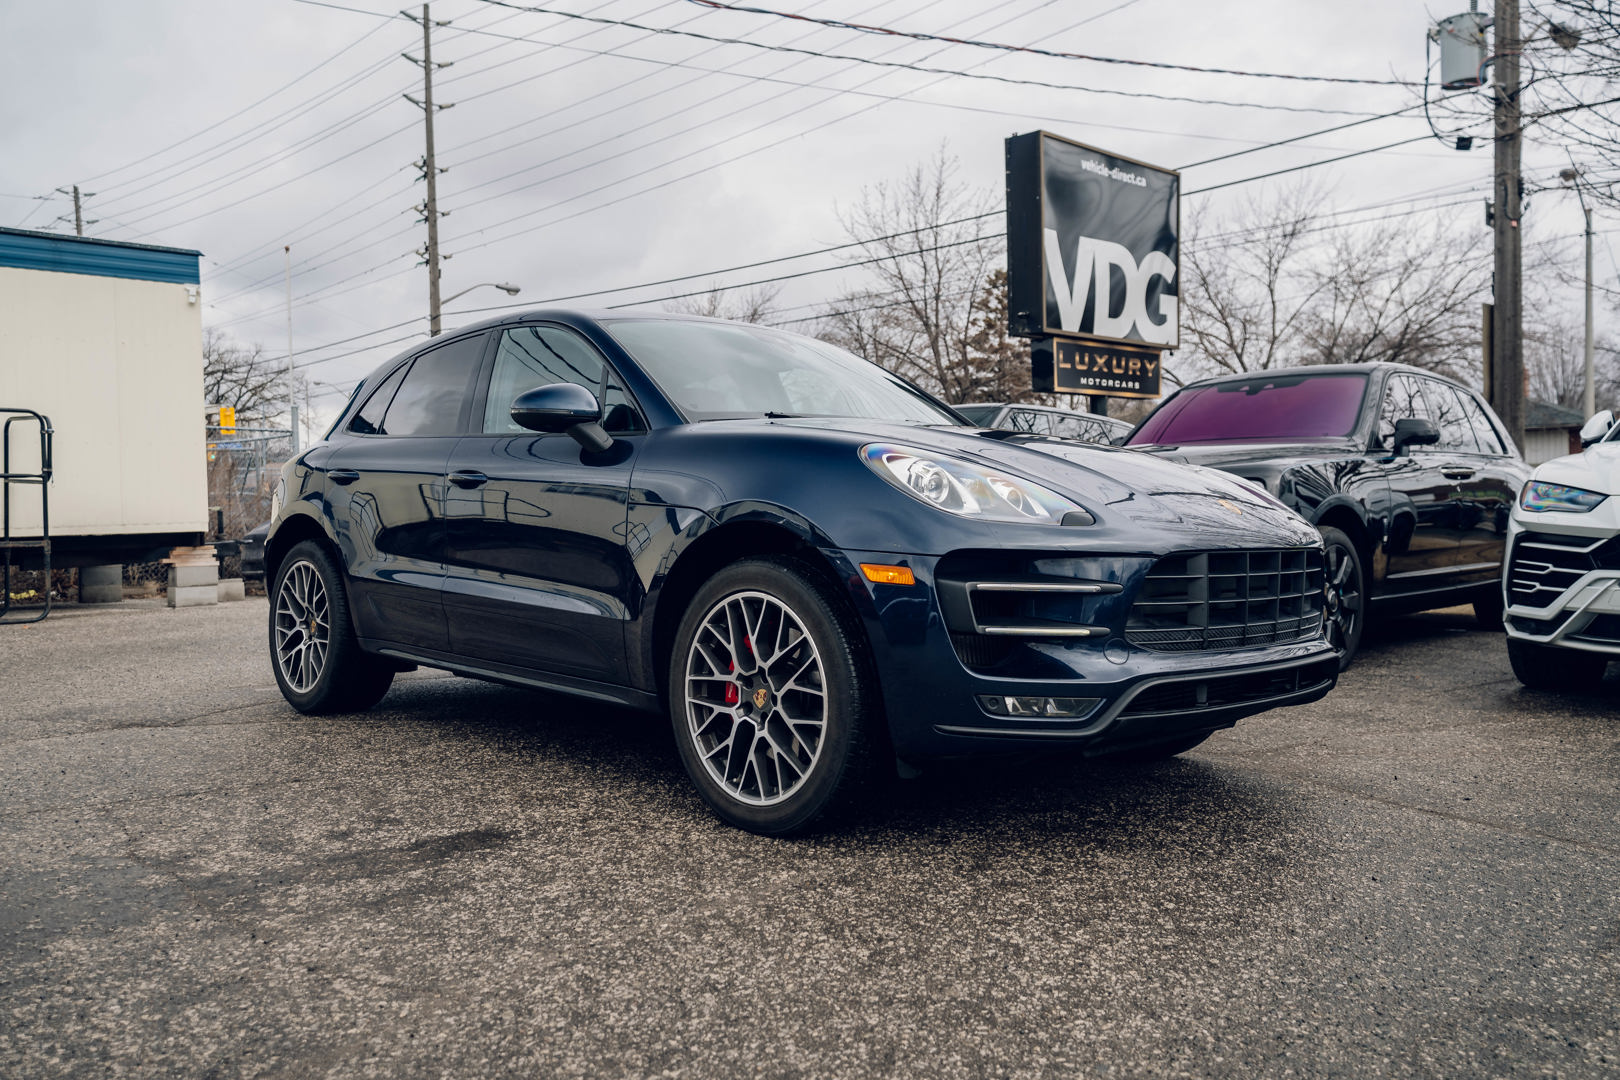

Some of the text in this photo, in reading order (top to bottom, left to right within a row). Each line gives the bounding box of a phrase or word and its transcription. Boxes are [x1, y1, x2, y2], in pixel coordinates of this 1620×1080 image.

[1081, 159, 1147, 188] vehicle-direct.ca
[1043, 227, 1178, 346] VDG
[1059, 349, 1157, 377] LUXURY
[1080, 377, 1140, 390] MOTORCARS
